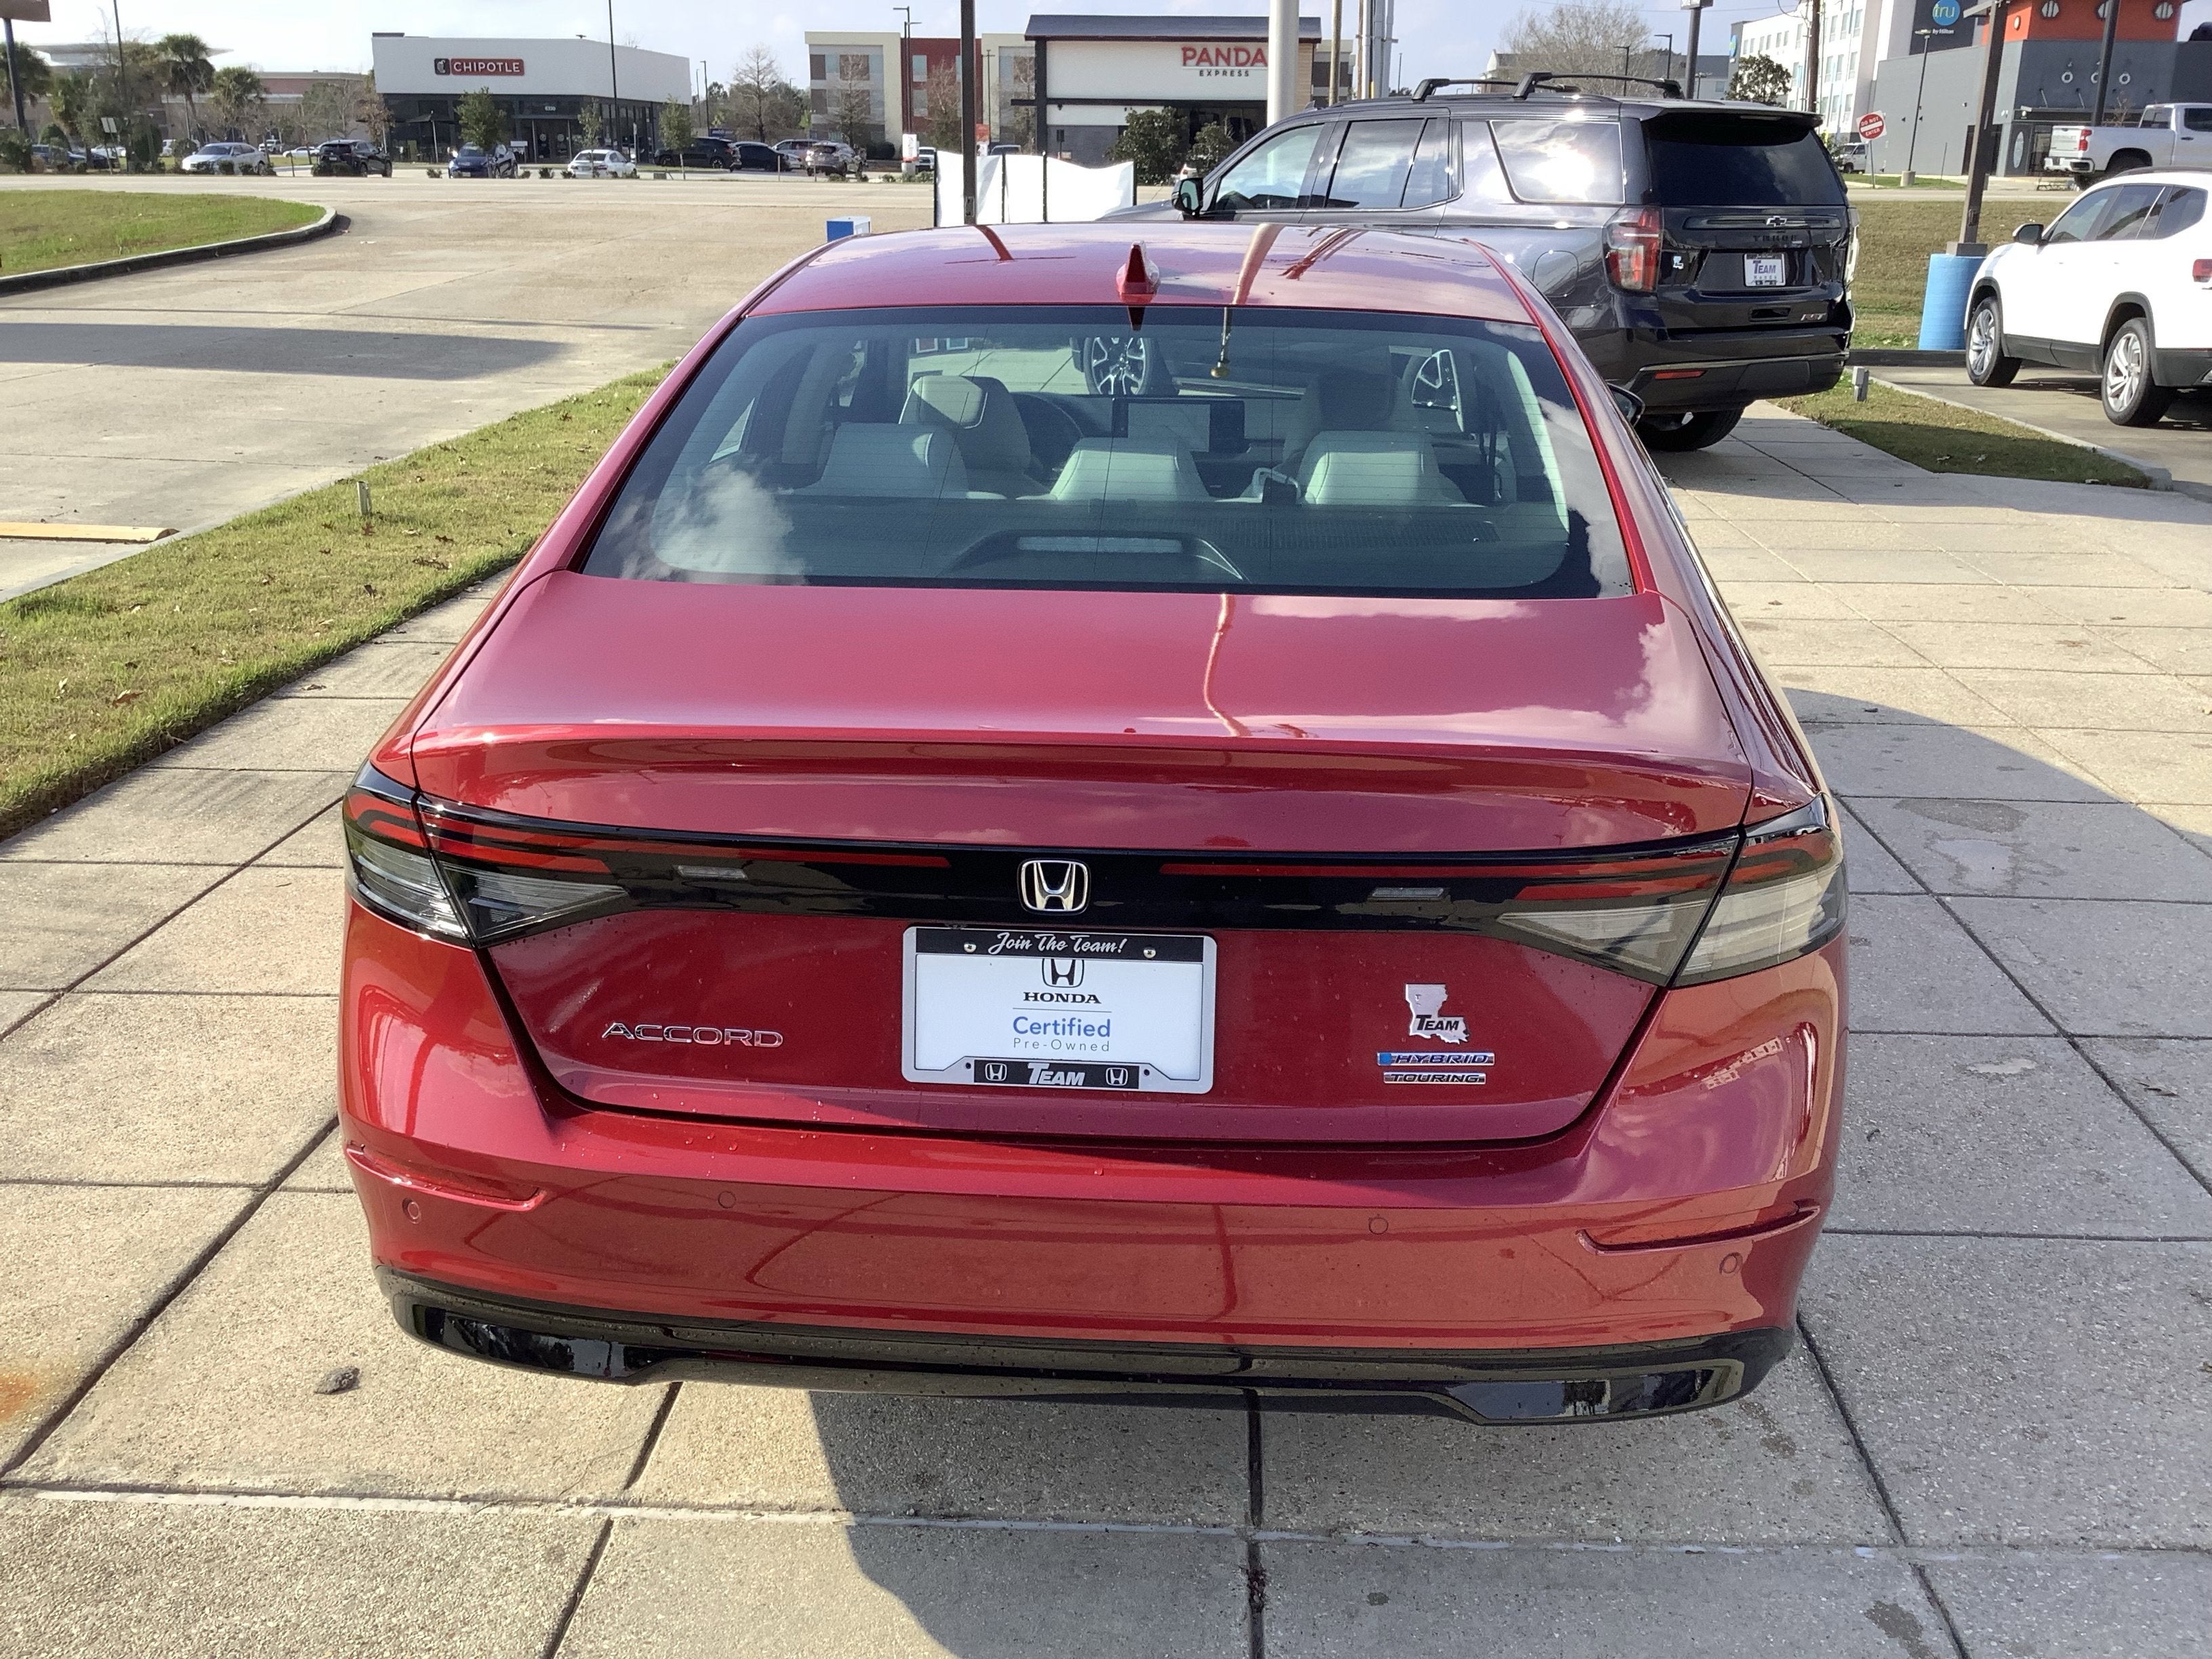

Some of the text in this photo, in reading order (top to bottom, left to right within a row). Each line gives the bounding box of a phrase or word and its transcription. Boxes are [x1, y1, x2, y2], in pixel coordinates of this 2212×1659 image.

[1934, 3, 1954, 18] tru
[1181, 47, 1268, 66] PANDA
[453, 62, 520, 73] CHIPOTLE
[988, 932, 1128, 955] Join The Team!
[1023, 991, 1102, 1004] HONDA
[1012, 1017, 1111, 1038] Certified
[601, 1022, 783, 1048] ACCORD
[1013, 1038, 1109, 1052] Pre-Owned
[1395, 1054, 1489, 1064] HYBRID
[1391, 1073, 1480, 1083] TOURING
